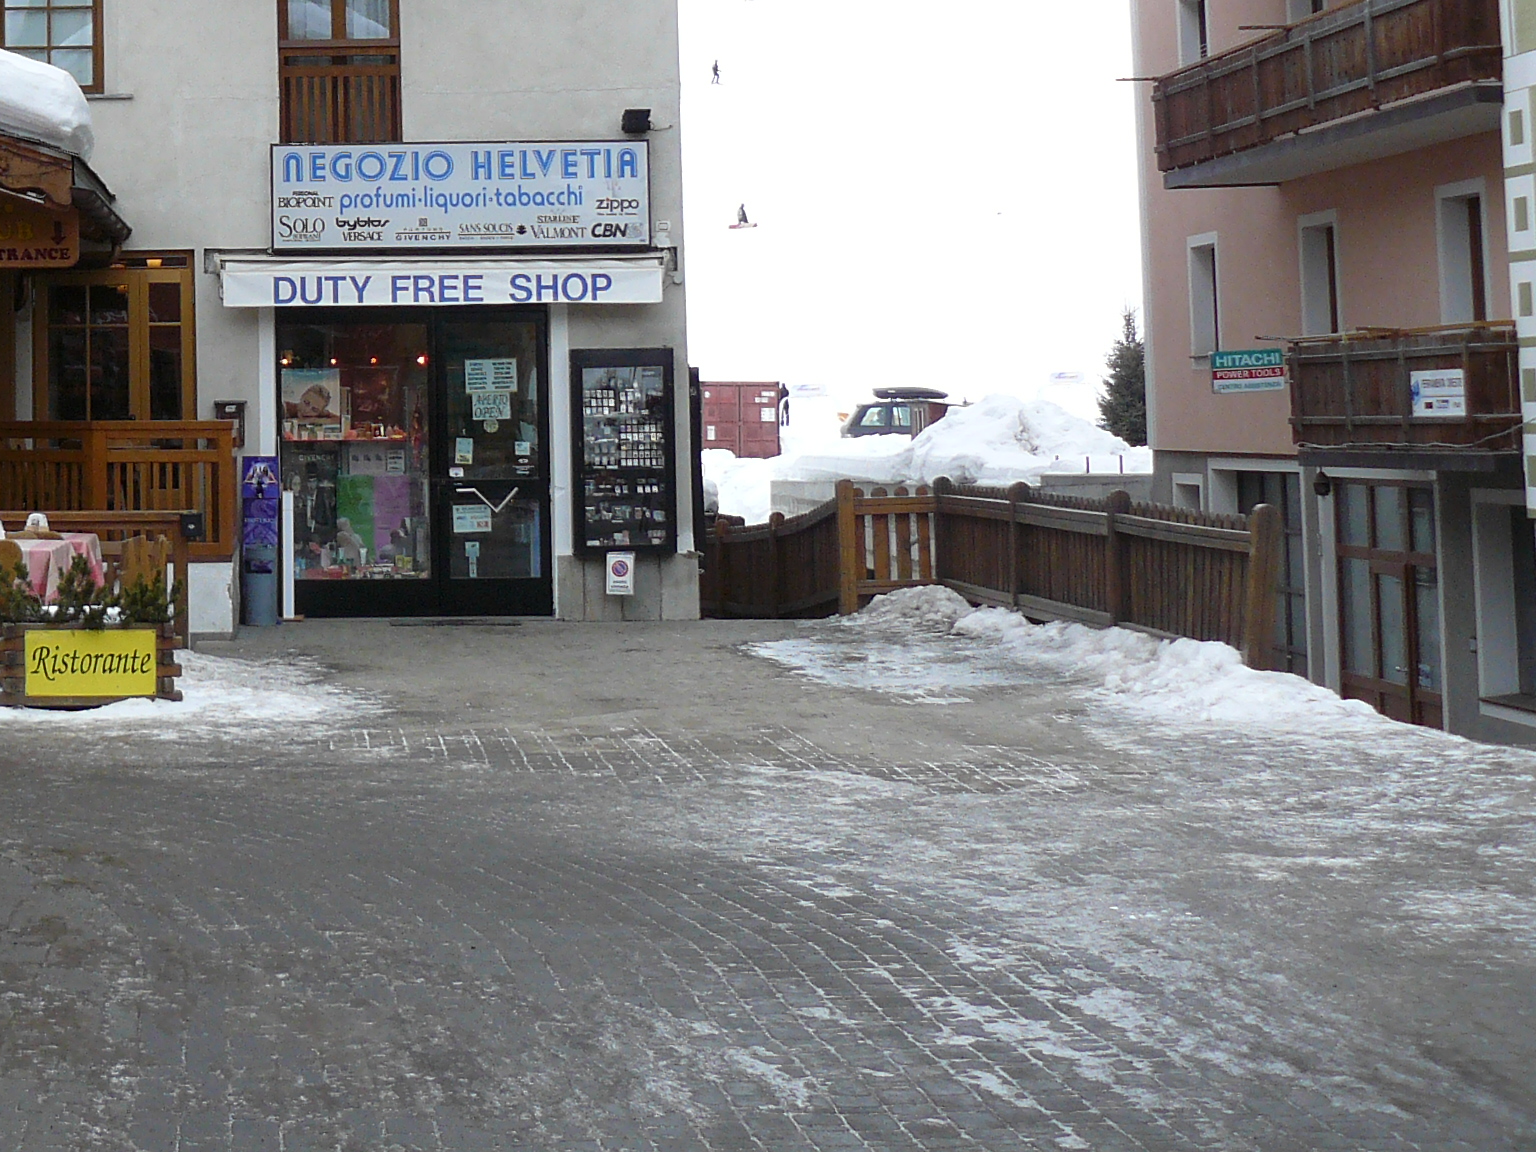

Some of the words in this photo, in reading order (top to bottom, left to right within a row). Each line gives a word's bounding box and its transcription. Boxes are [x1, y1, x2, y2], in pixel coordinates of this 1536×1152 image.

[282, 150, 455, 183] NEGOZIO
[470, 147, 638, 181] HELVETIA
[277, 196, 335, 209] BIOPOINT
[594, 197, 640, 213] zippo
[278, 215, 326, 238] SOLO
[458, 222, 483, 234] SANS
[530, 224, 588, 240] VALMONT
[590, 222, 629, 239] CBN
[341, 231, 384, 242] VERSACE
[394, 233, 452, 241] GIVENCHY
[272, 275, 373, 305] DUTY
[390, 274, 485, 303] FREE
[508, 272, 613, 302] SHOP
[1215, 352, 1282, 367] HITACHI
[1216, 370, 1250, 379] POWER
[1252, 368, 1282, 377] TOOLS
[474, 407, 505, 419] OPEN
[30, 644, 153, 682] Ristorante
